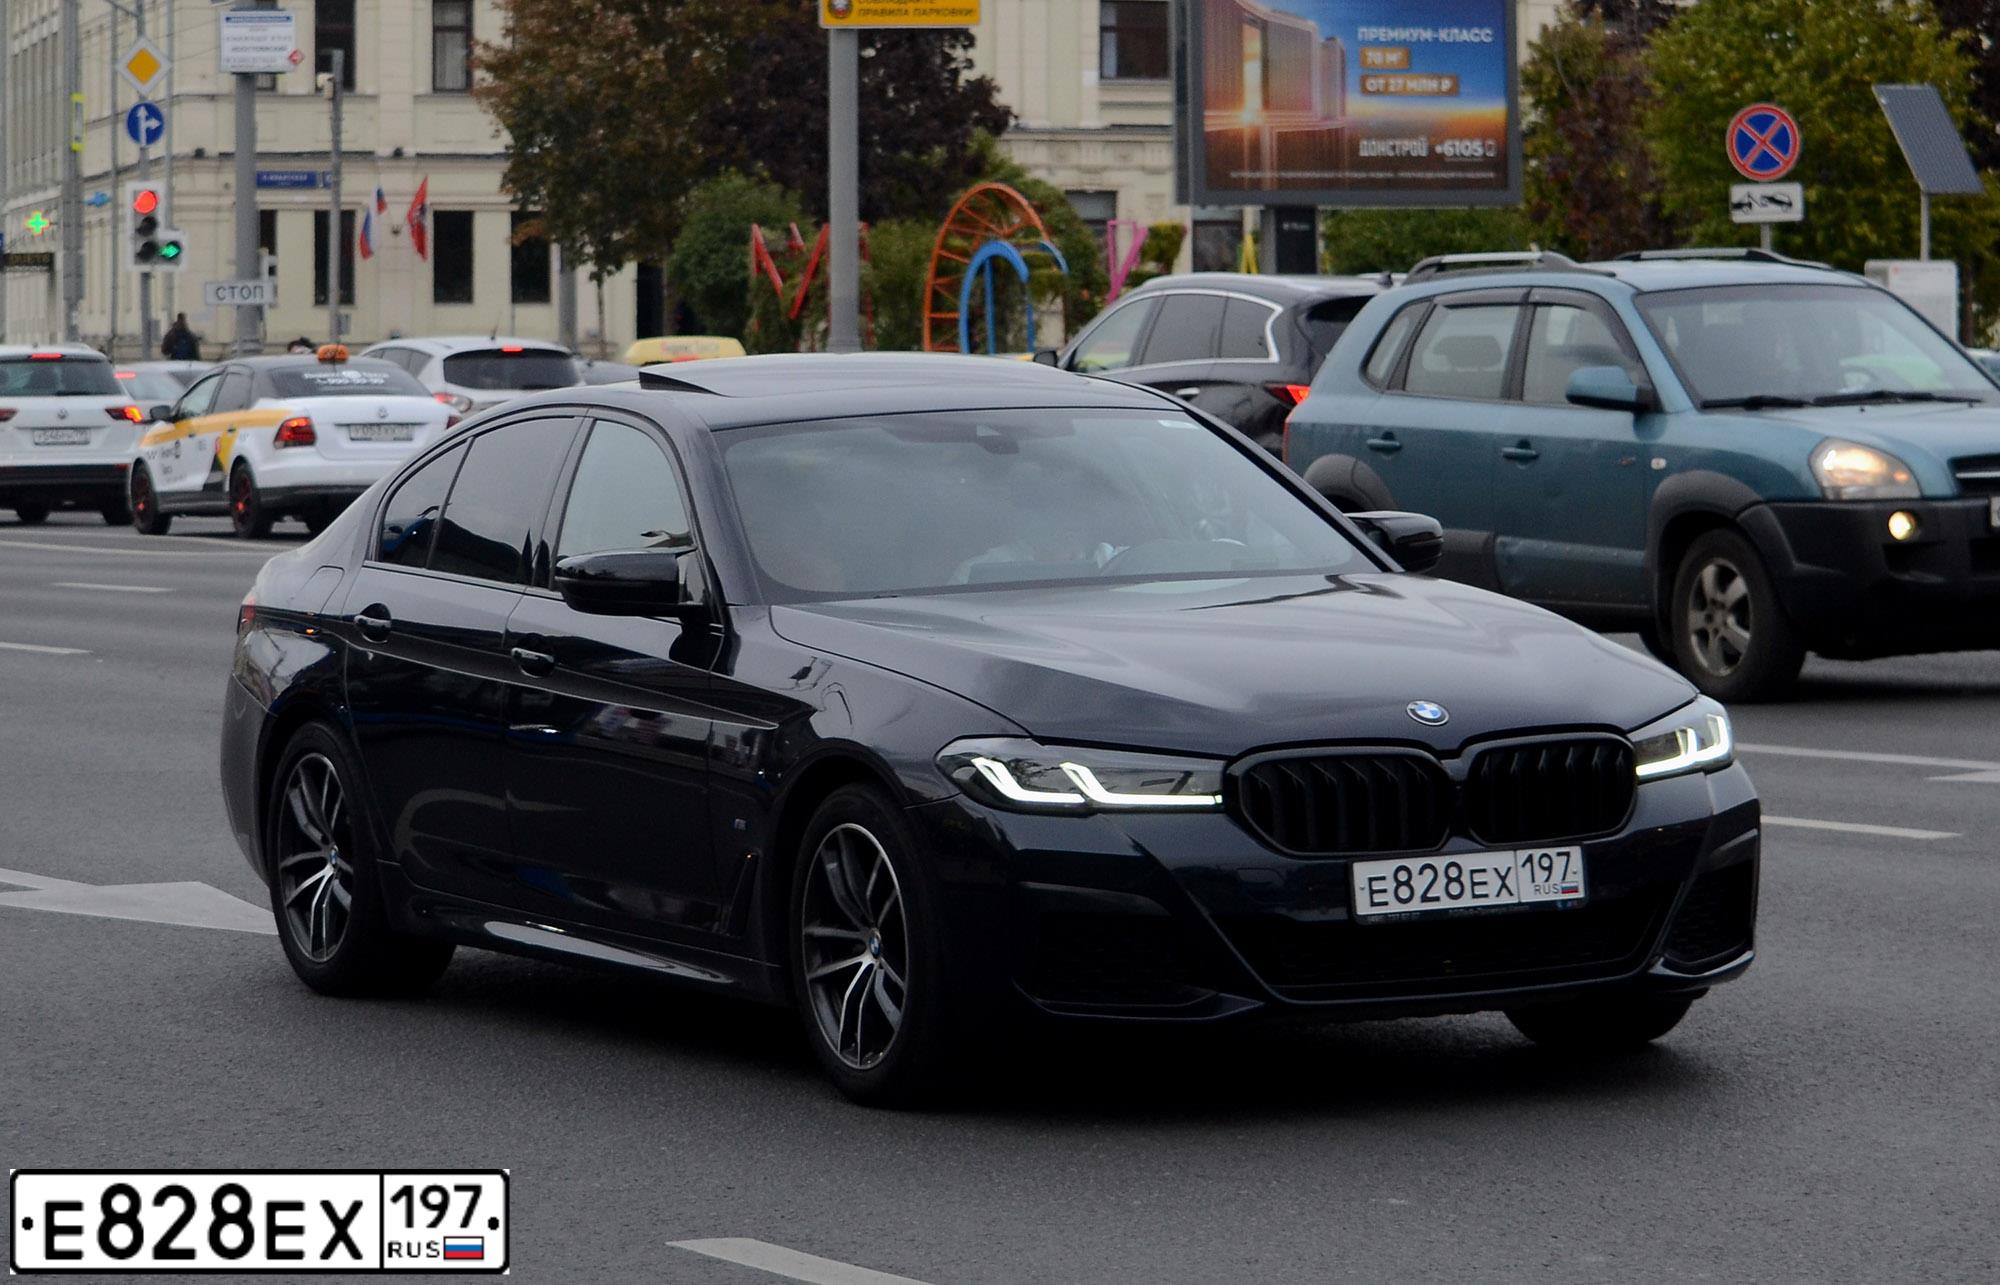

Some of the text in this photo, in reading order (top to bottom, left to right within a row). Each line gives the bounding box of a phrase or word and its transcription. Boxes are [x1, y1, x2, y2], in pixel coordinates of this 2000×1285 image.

[858, 8, 908, 16] ПРАВИЛА
[1357, 27, 1493, 43] ПРЕМИУМ-КЛАСС
[1365, 79, 1386, 92] ОТ
[1359, 137, 1428, 157] ДОНСТРОЙ
[215, 286, 264, 301] СТОП
[1367, 851, 1571, 908] E828EX 197
[1534, 884, 1560, 896] RUS
